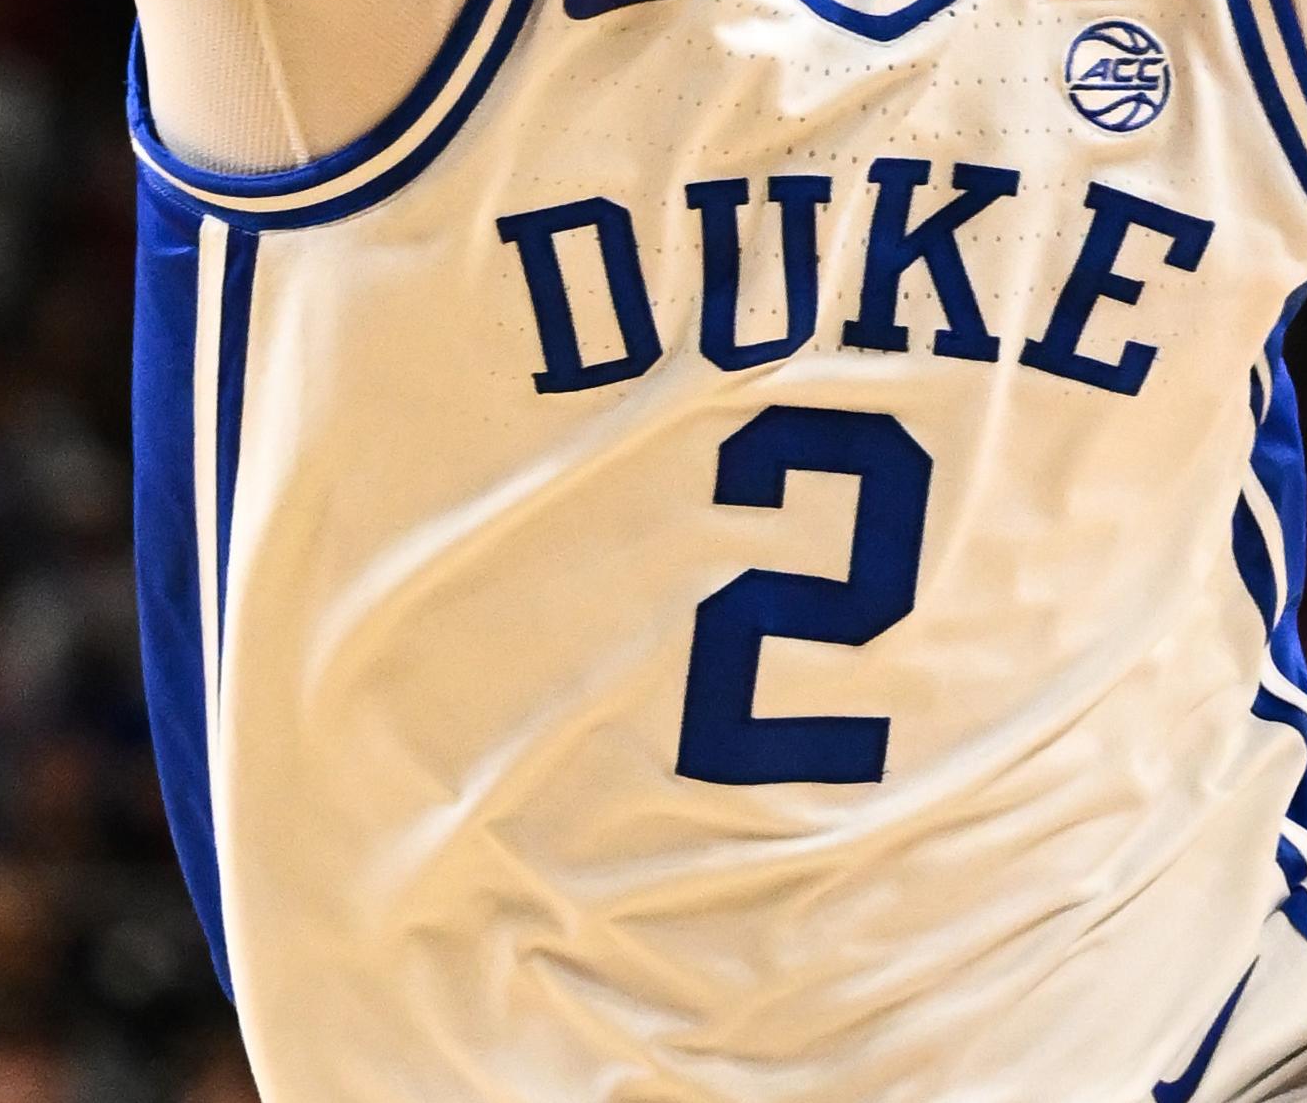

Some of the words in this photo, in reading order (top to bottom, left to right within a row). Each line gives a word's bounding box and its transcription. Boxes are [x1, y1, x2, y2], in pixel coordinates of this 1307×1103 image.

[1080, 57, 1165, 83] ACC
[496, 157, 1214, 396] DUKE
[675, 404, 933, 785] 2
